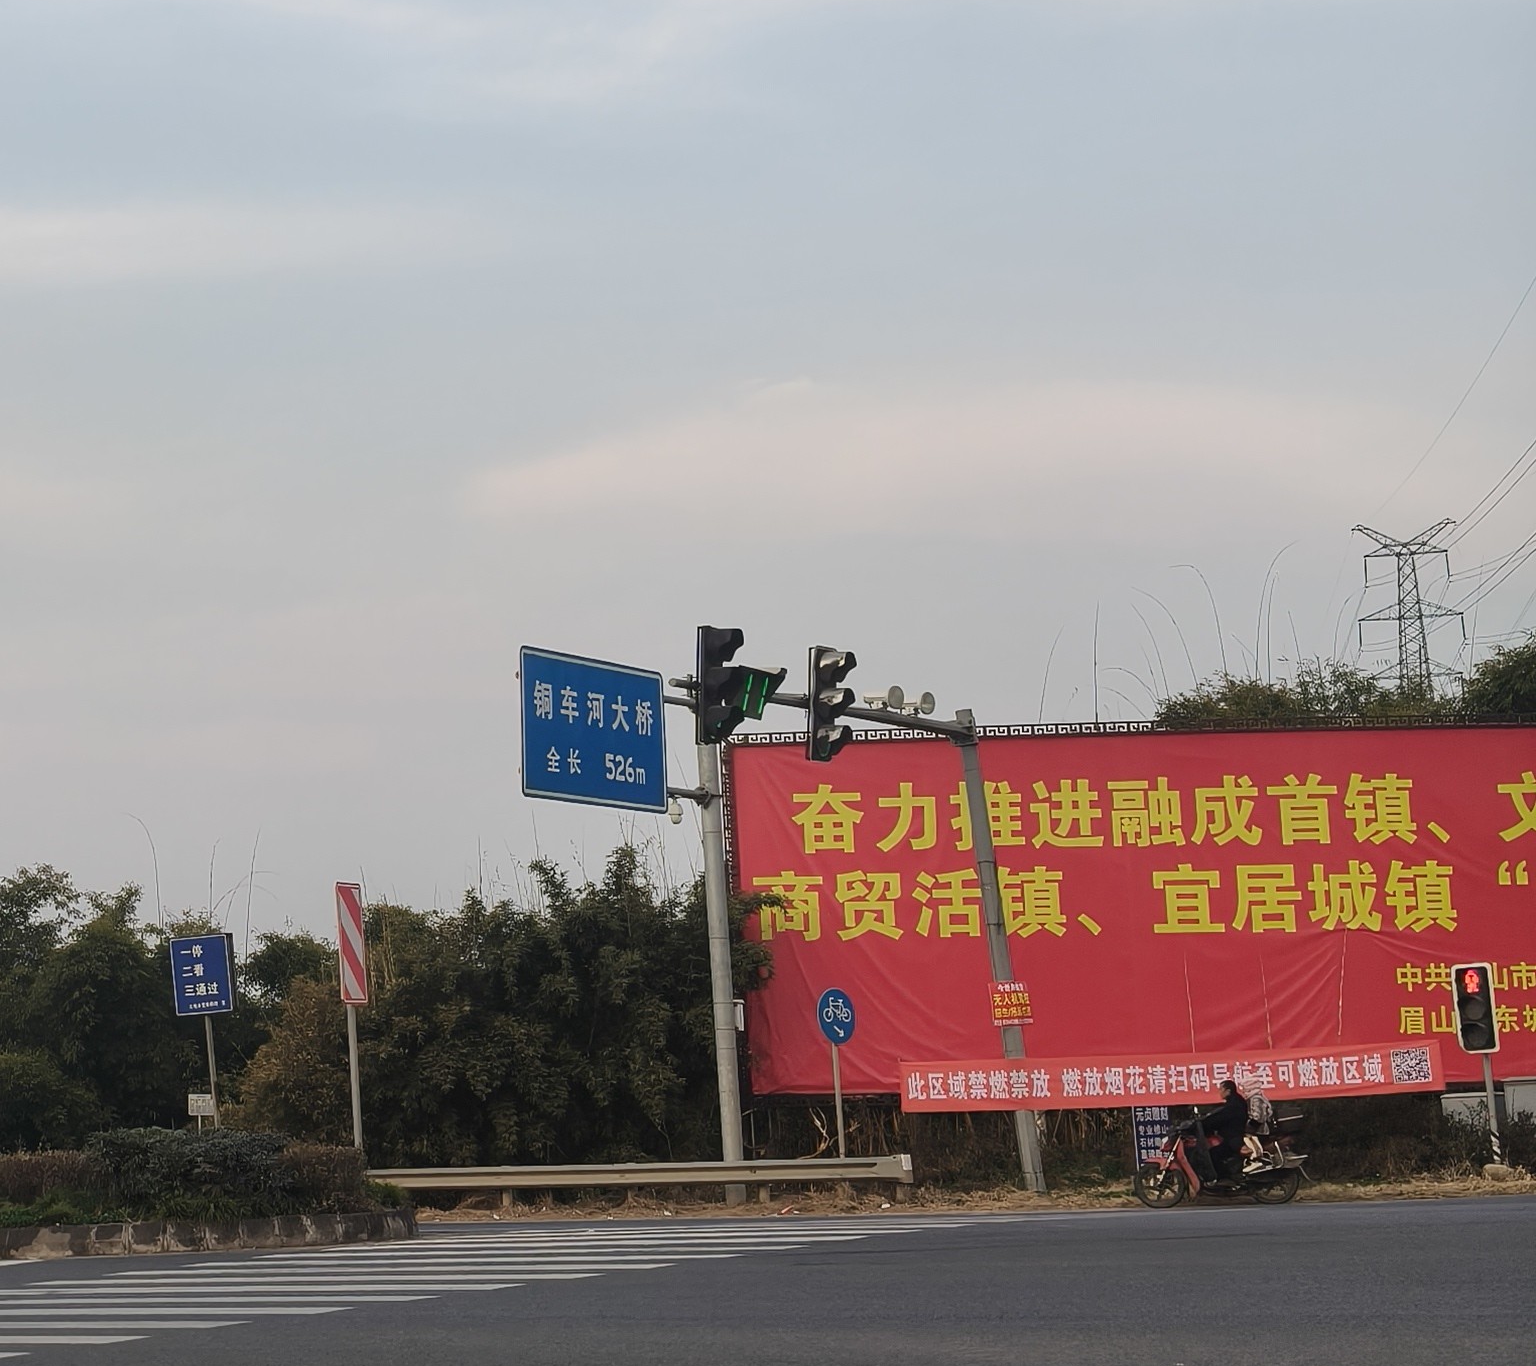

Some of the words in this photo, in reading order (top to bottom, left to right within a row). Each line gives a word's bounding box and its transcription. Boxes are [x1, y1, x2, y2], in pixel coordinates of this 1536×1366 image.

[546, 746, 582, 774] 全长
[605, 753, 646, 785] 526m
[184, 981, 219, 996] 三通过
[1396, 961, 1536, 992] 中共山市
[1399, 1004, 1536, 1035] 眉山东
[907, 1068, 1051, 1100] 此区域禁燃禁放
